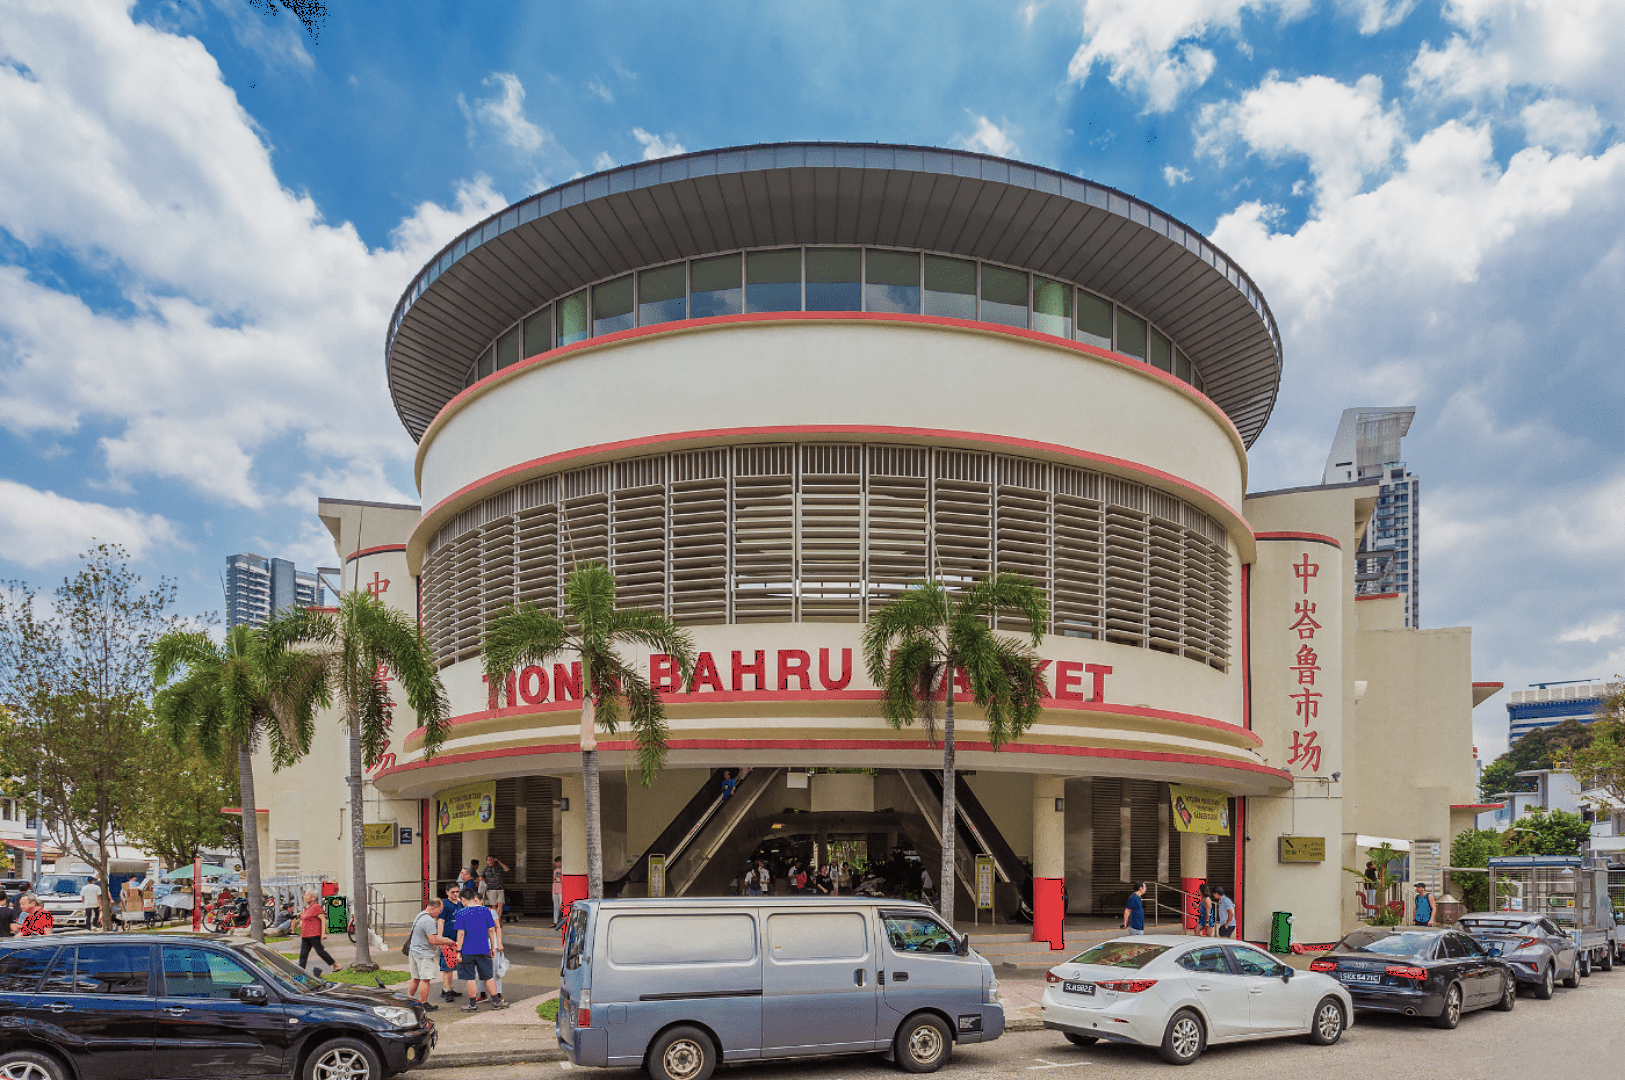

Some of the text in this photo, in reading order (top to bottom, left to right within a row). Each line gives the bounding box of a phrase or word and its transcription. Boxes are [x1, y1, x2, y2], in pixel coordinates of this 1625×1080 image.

[482, 660, 622, 709] TION
[650, 648, 852, 693] BAHRU
[1287, 553, 1323, 773] 中峇鲁市场
